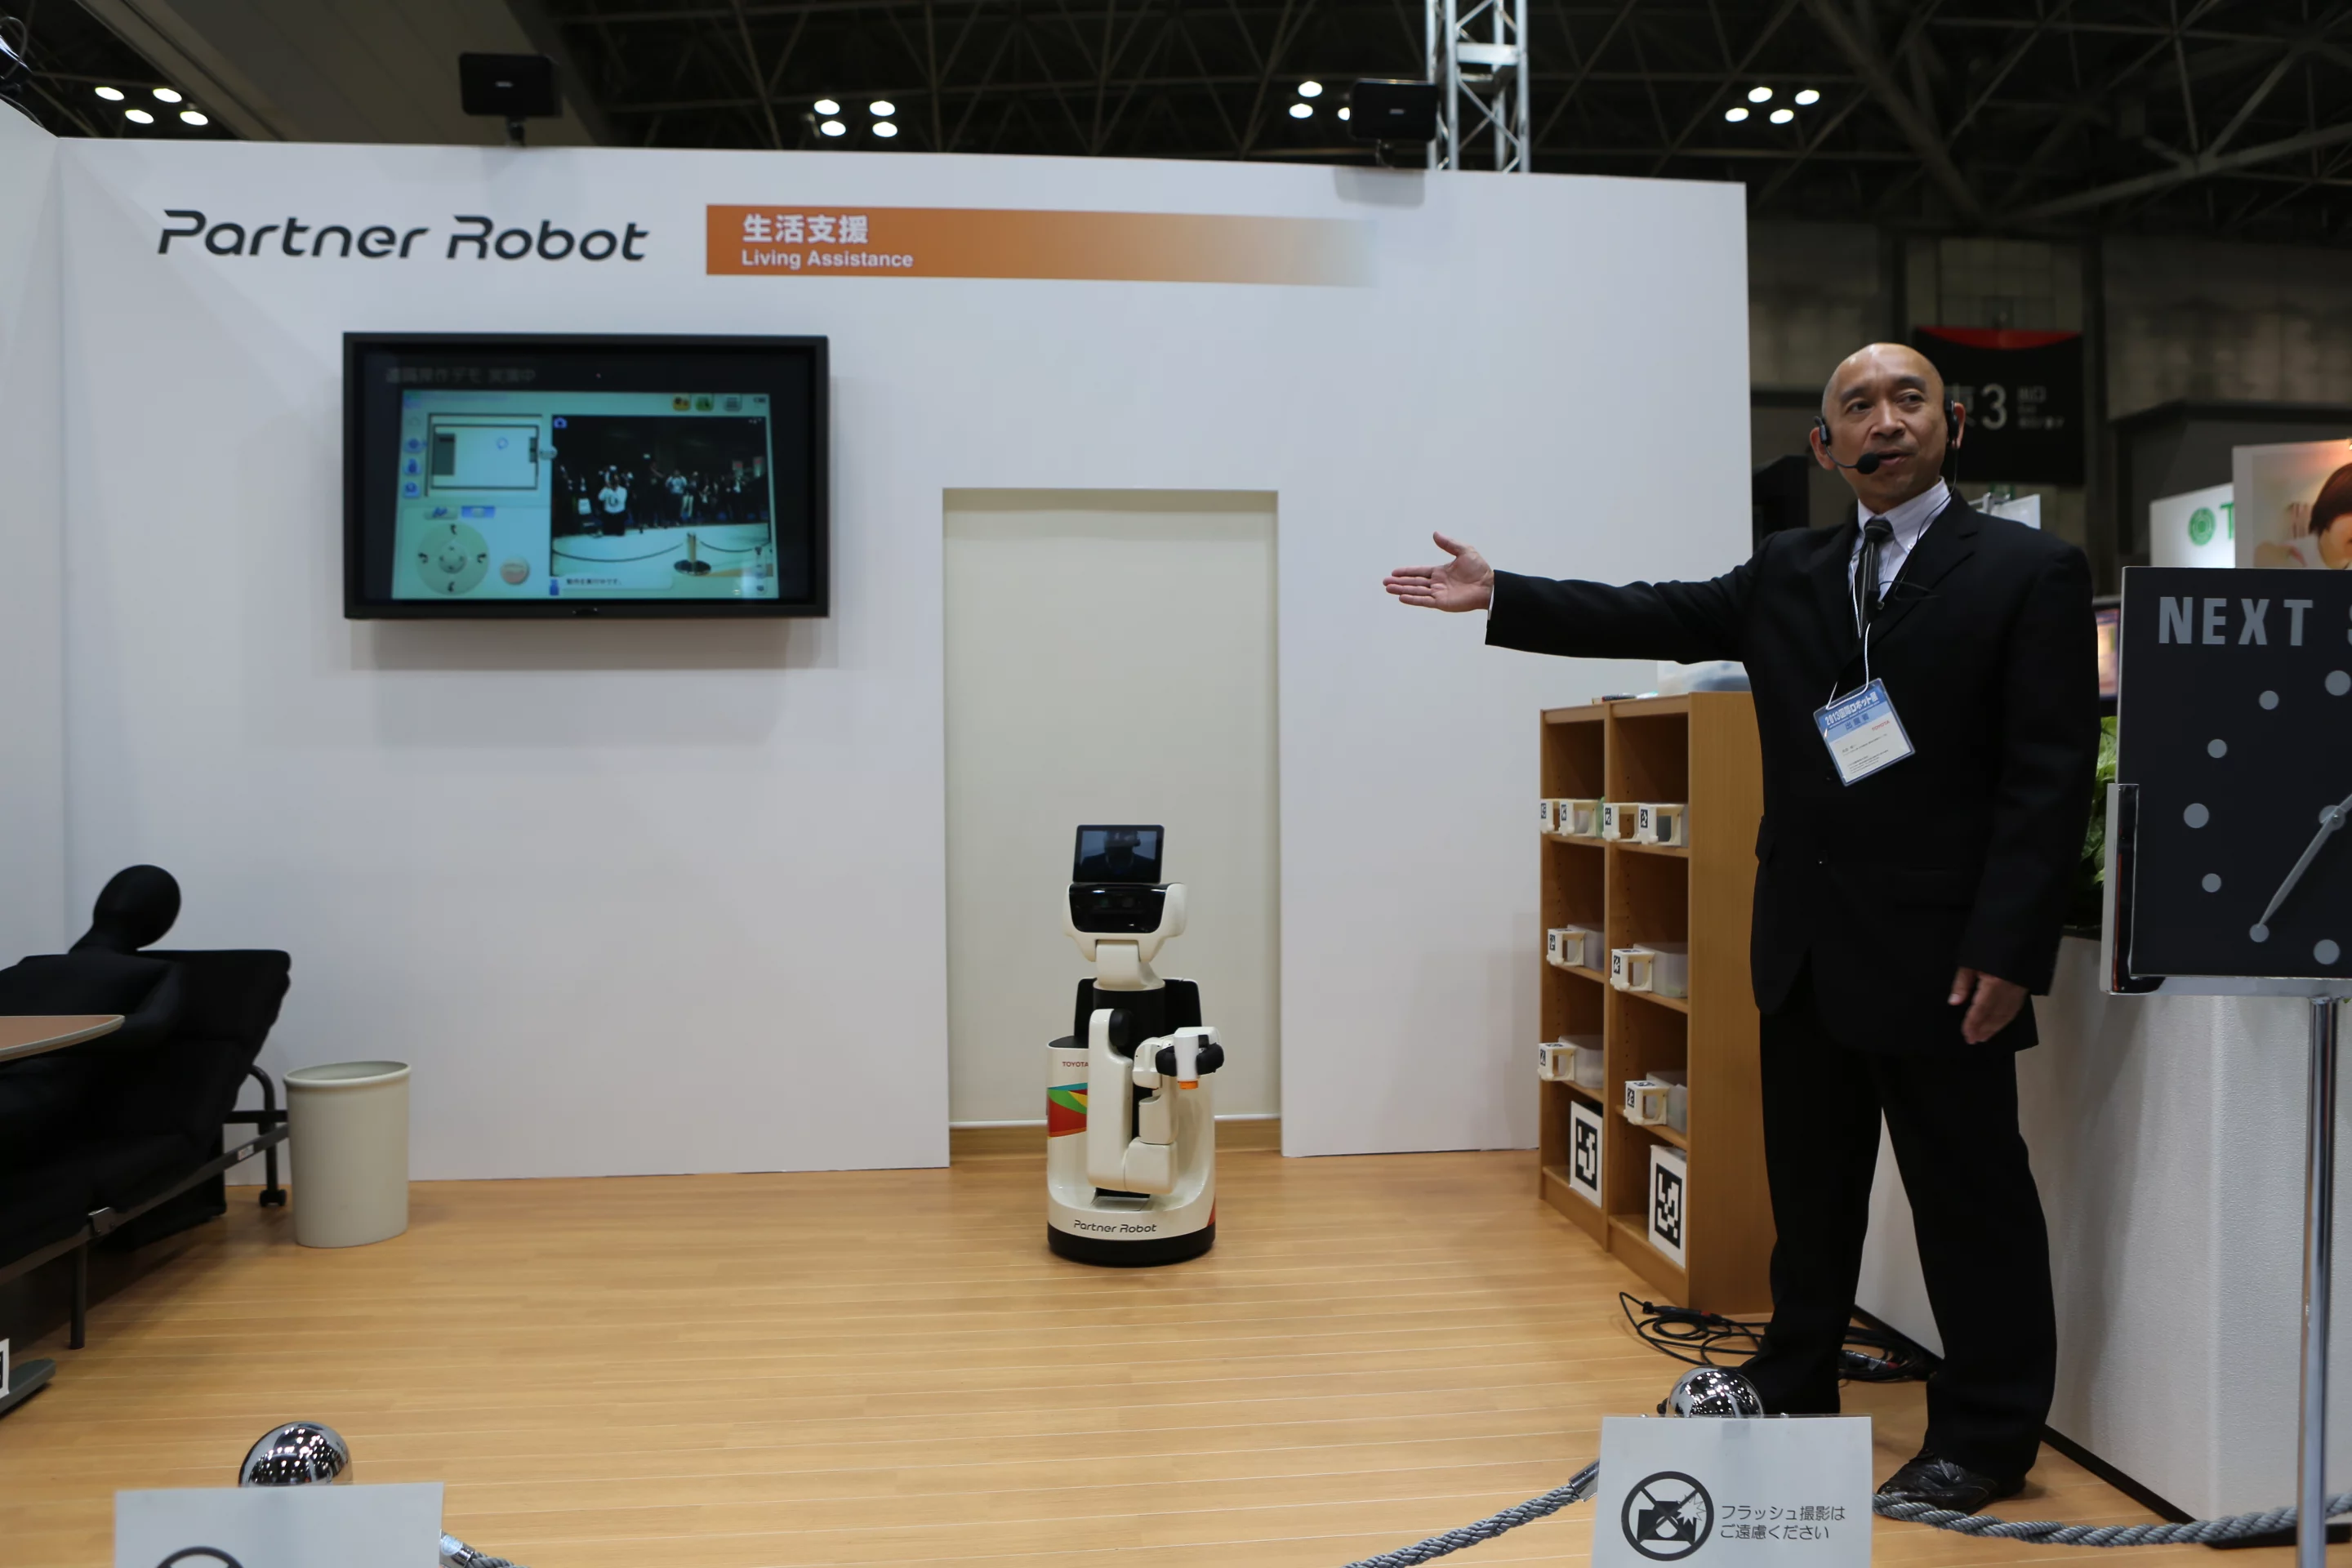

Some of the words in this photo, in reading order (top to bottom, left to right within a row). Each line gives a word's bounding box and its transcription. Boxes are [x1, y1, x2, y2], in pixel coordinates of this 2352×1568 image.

[158, 210, 429, 259] Partner
[447, 215, 649, 262] Robot
[742, 214, 869, 244] 生活支援
[741, 249, 801, 270] Living
[807, 250, 914, 269] Assistance
[2158, 596, 2314, 646] NEXT
[1073, 1219, 1117, 1233] Partner
[1120, 1224, 1157, 1233] Robot
[1722, 1504, 1846, 1522] フラッシュ撮影は
[1721, 1524, 1829, 1540] ご遠慮ください
